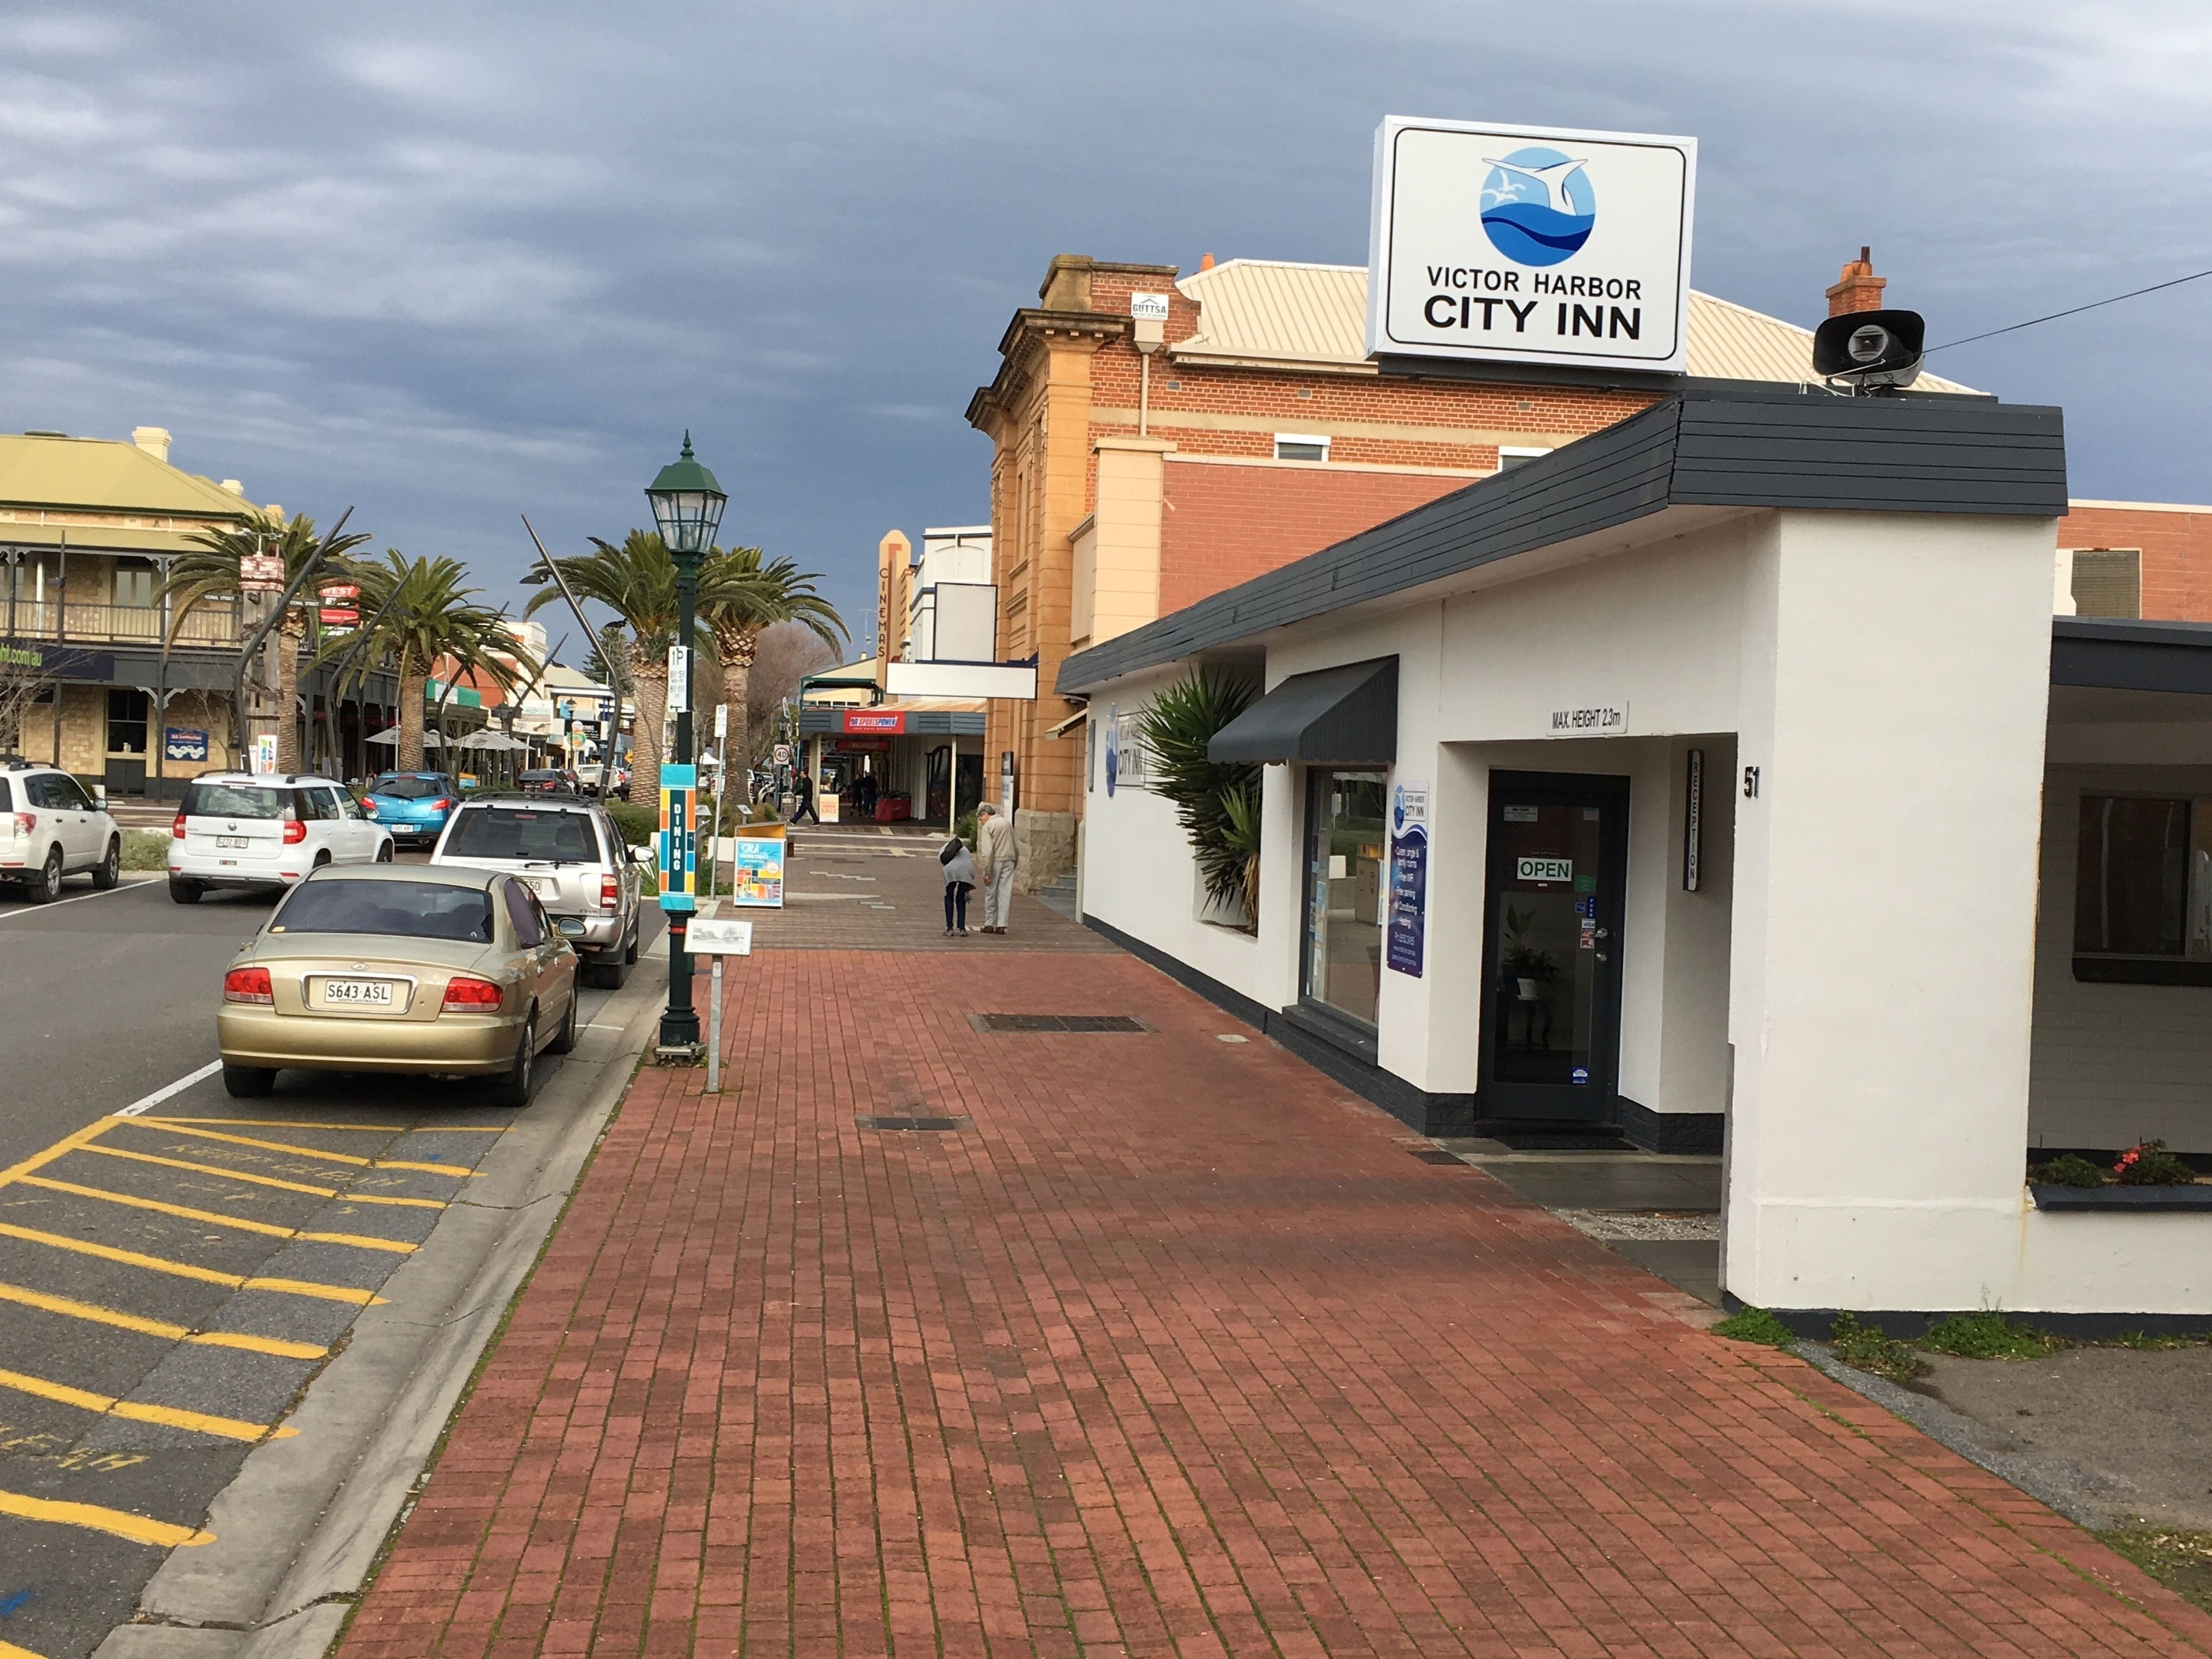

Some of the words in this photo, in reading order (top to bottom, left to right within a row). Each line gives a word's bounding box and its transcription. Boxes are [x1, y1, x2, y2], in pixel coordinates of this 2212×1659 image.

[1426, 266, 1520, 292] VICTOR
[1534, 273, 1642, 300] HARBOR
[1132, 304, 1166, 314] GUTTSA
[1423, 294, 1539, 333] CITY
[1557, 302, 1641, 340] INN
[321, 586, 354, 595] WEST
[878, 567, 889, 657] CINEMAS
[672, 647, 684, 665] 1P
[1552, 711, 1570, 729] MAX.
[1571, 709, 1601, 729] HEIGHT
[1744, 766, 1760, 798] 51
[673, 804, 681, 870] DINING
[1690, 762, 1699, 880] RECEPTION
[1520, 861, 1569, 878] OPEN
